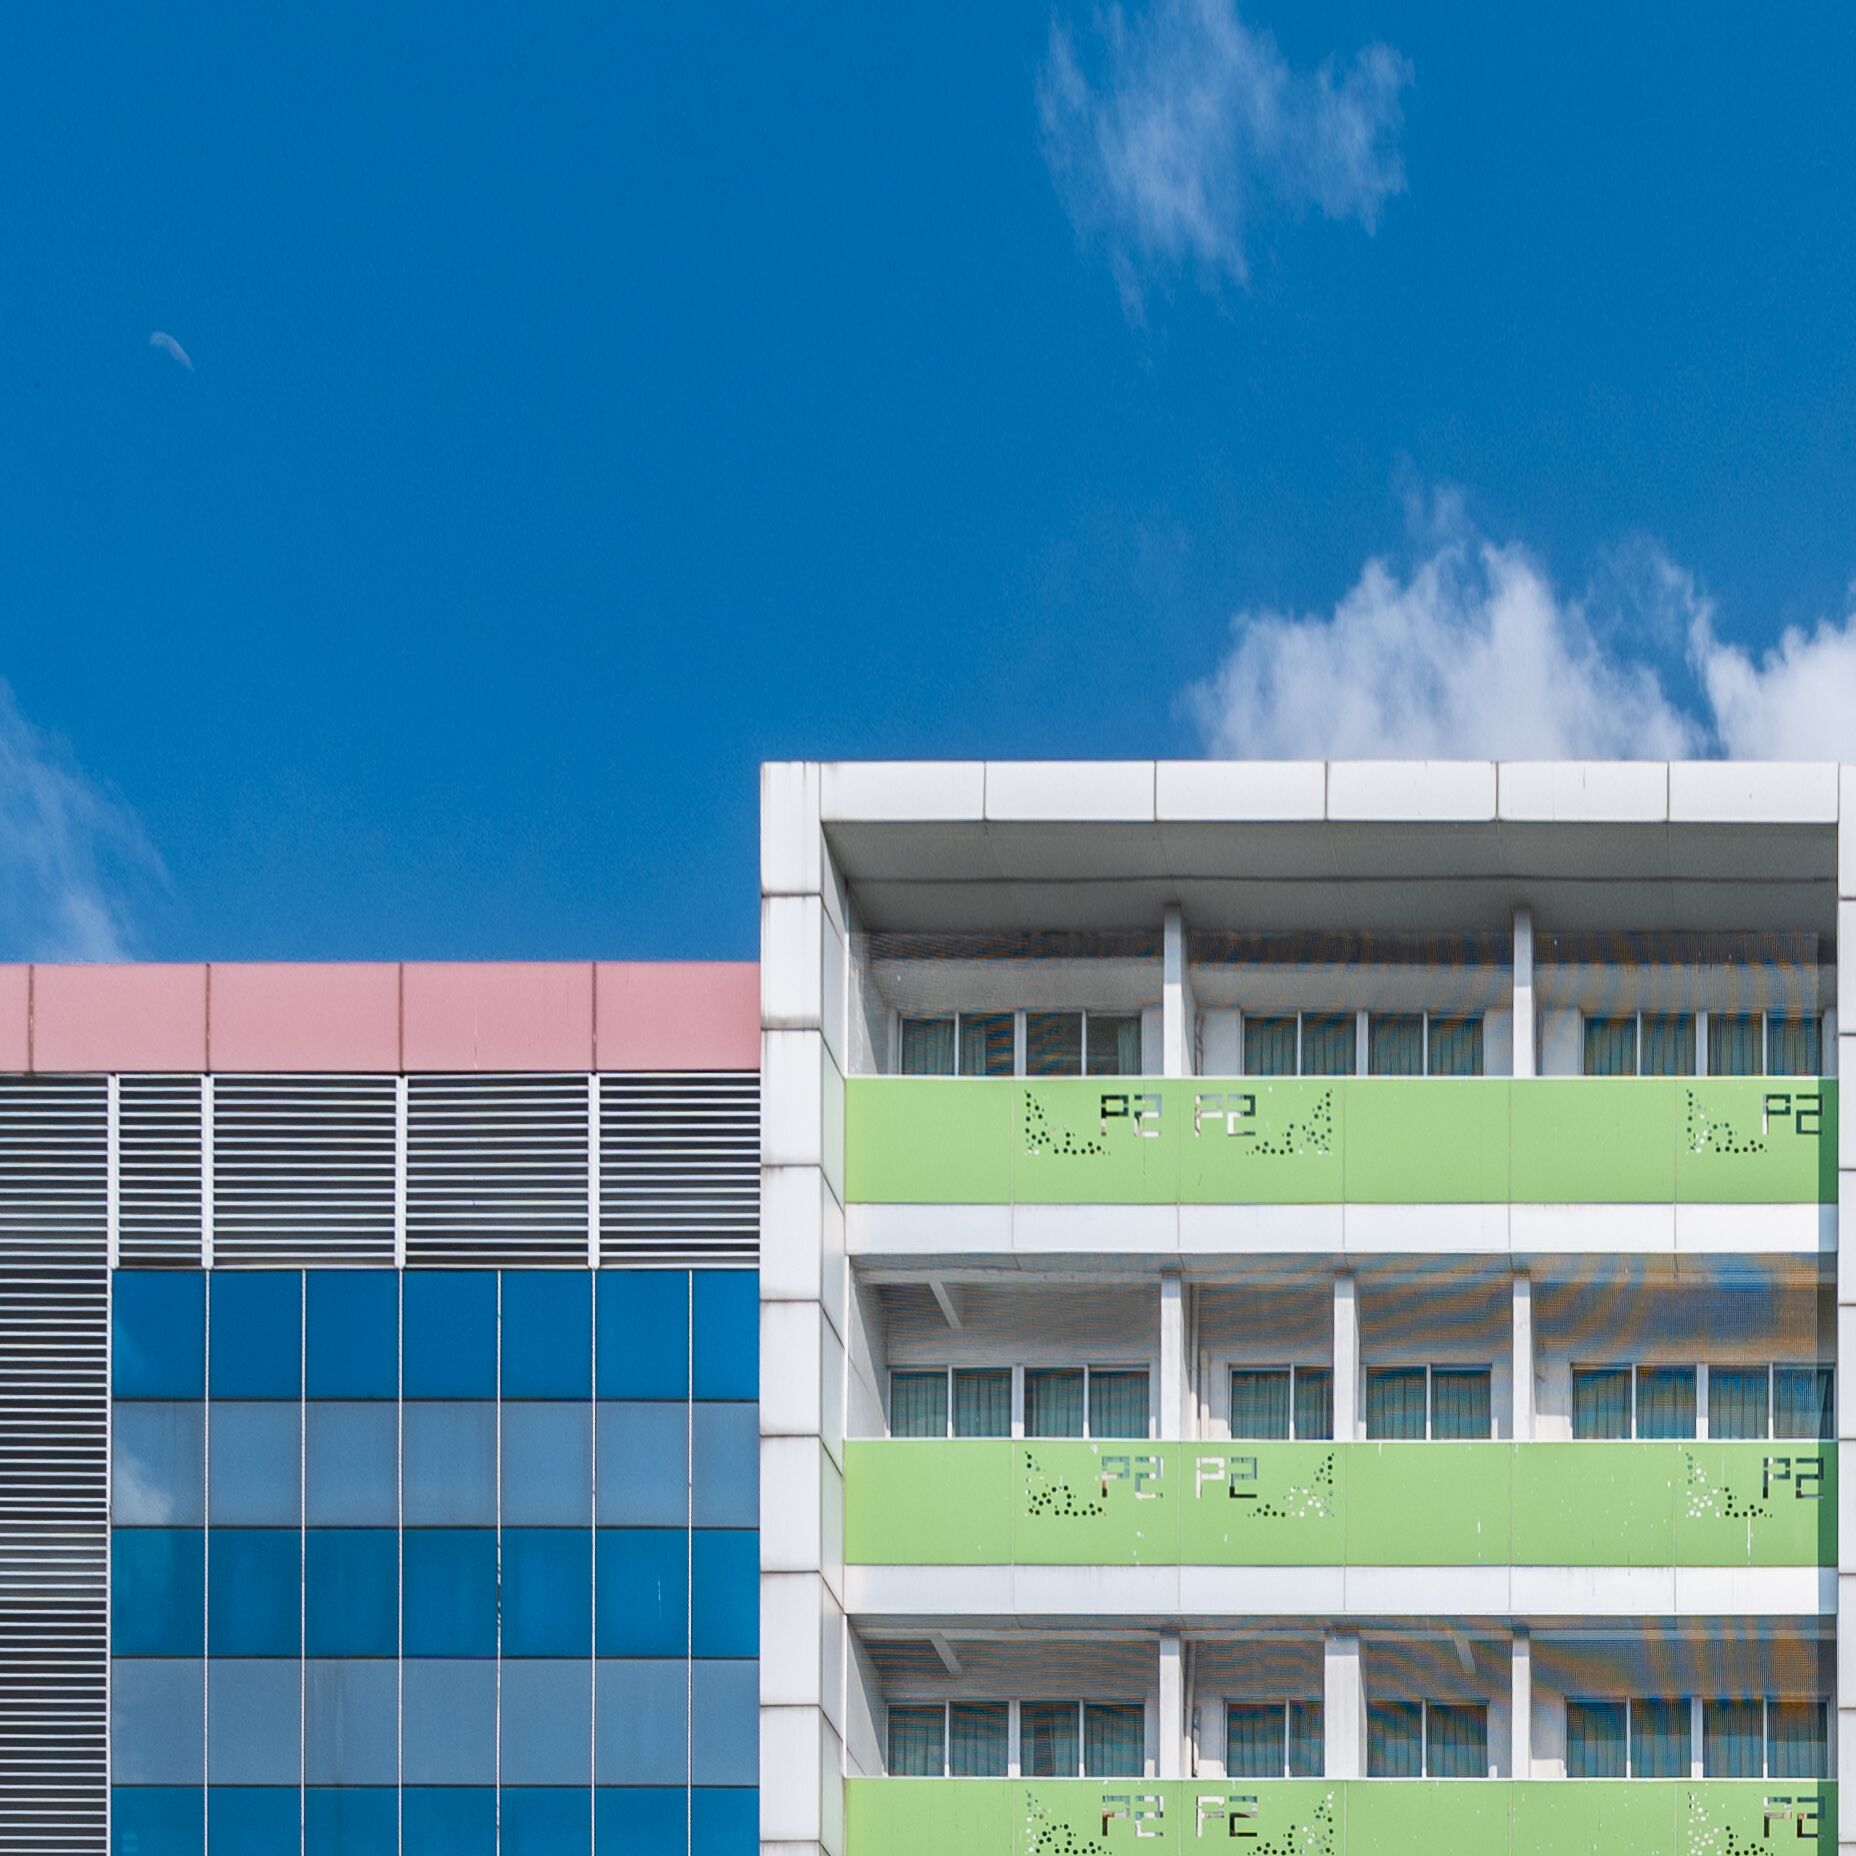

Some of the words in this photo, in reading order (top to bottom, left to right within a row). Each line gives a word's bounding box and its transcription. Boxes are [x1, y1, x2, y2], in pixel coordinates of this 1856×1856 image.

[1101, 1094, 1163, 1137] P2
[1195, 1094, 1257, 1137] P2
[1763, 1094, 1825, 1137] P2
[1101, 1456, 1163, 1499] P2
[1195, 1456, 1257, 1499] P2
[1763, 1456, 1825, 1499] P2
[1101, 1795, 1163, 1838] P2
[1195, 1795, 1257, 1838] P2
[1763, 1795, 1825, 1838] P2
